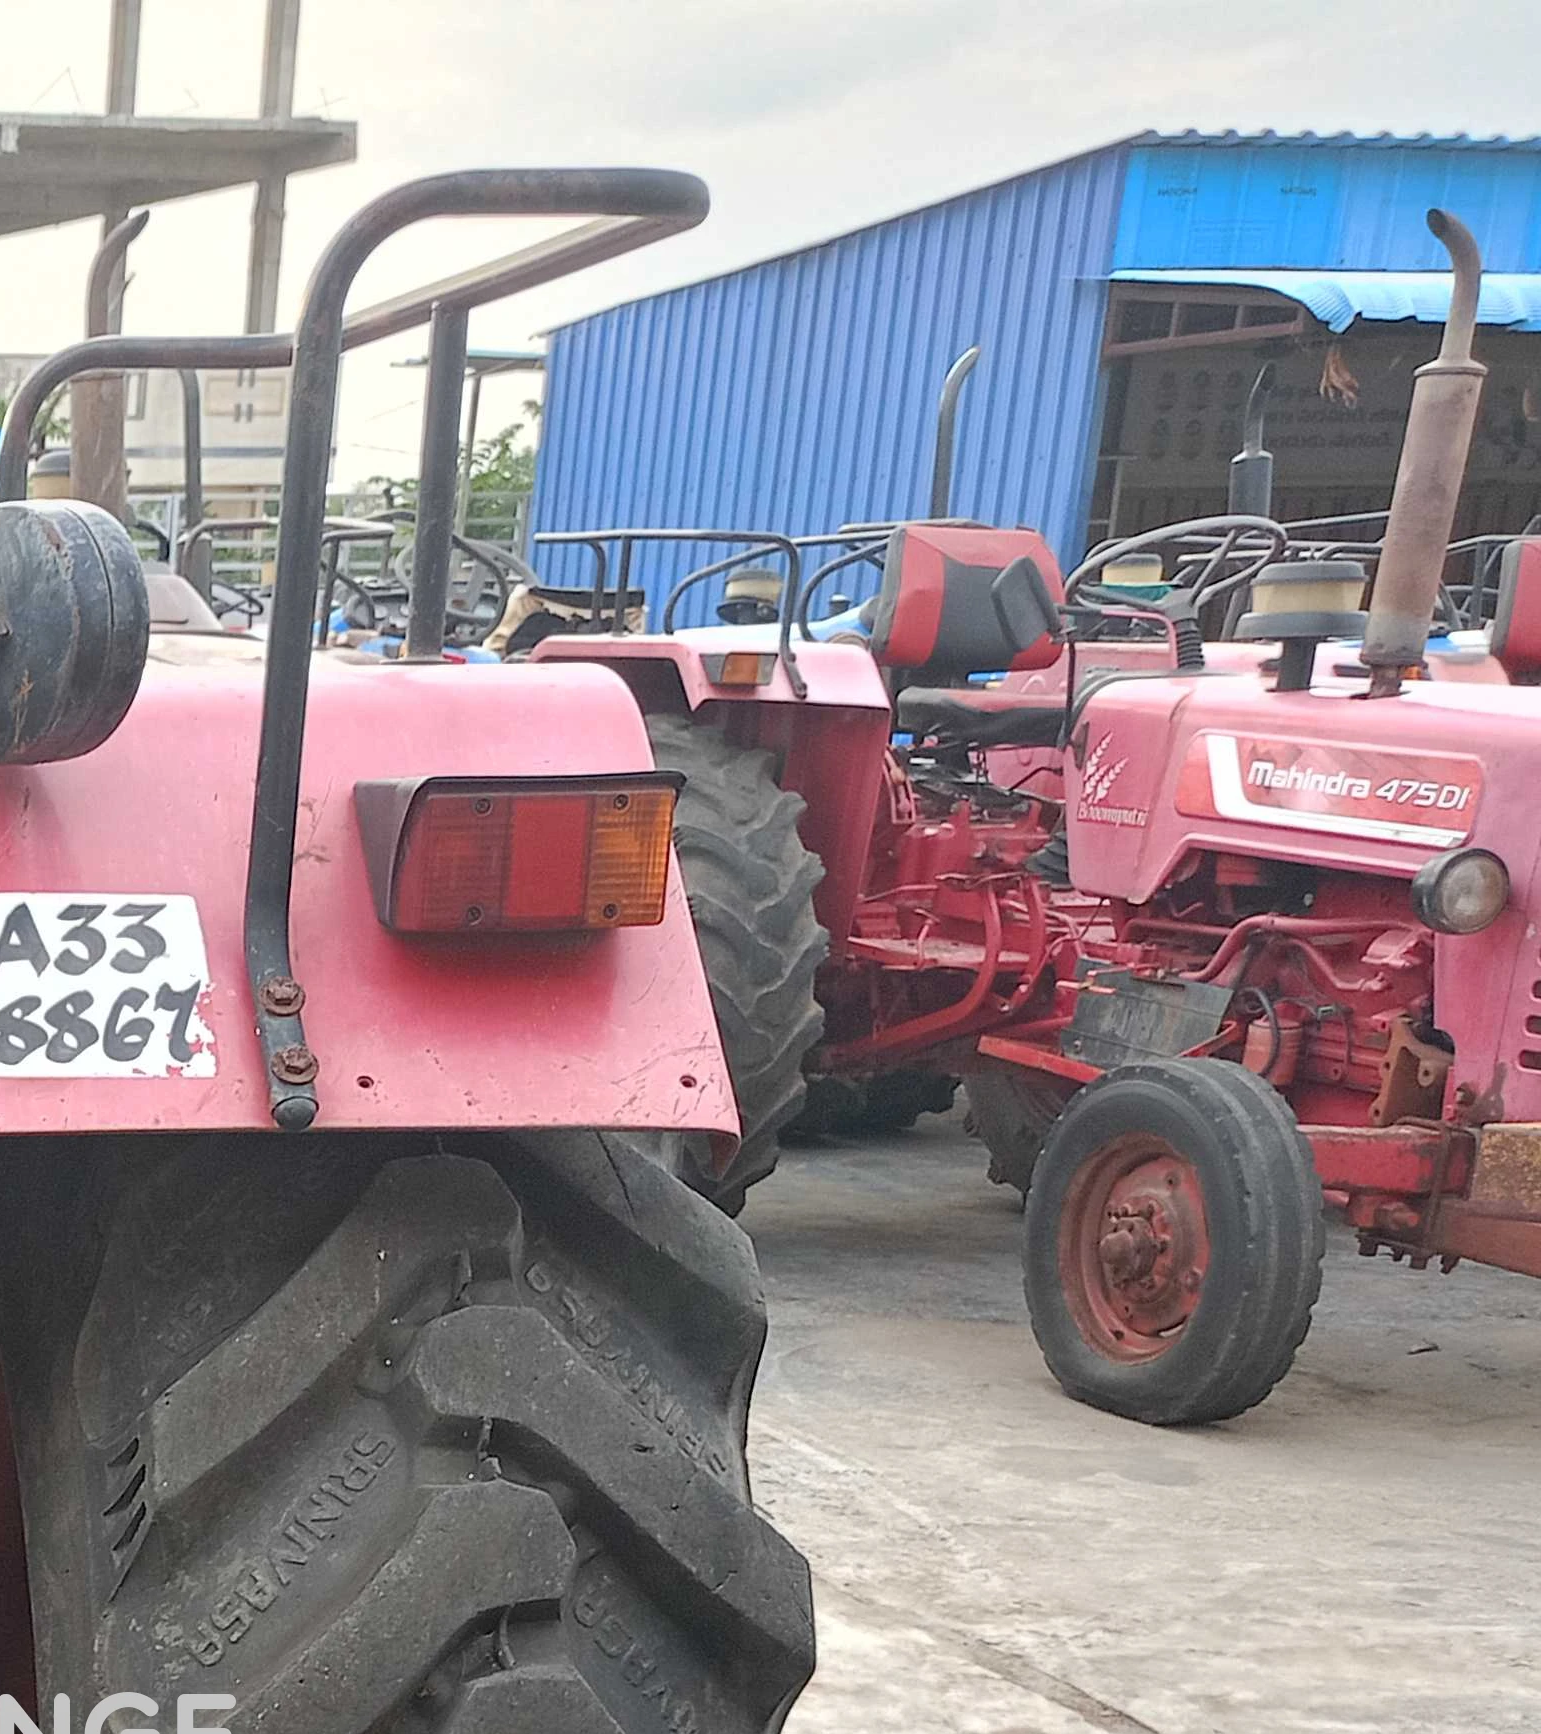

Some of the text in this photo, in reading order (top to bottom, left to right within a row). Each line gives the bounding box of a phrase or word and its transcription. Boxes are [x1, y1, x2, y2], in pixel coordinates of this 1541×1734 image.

[1248, 760, 1472, 811] Mahindra 475DI
[188, 1431, 395, 1667] SRINIVASA
